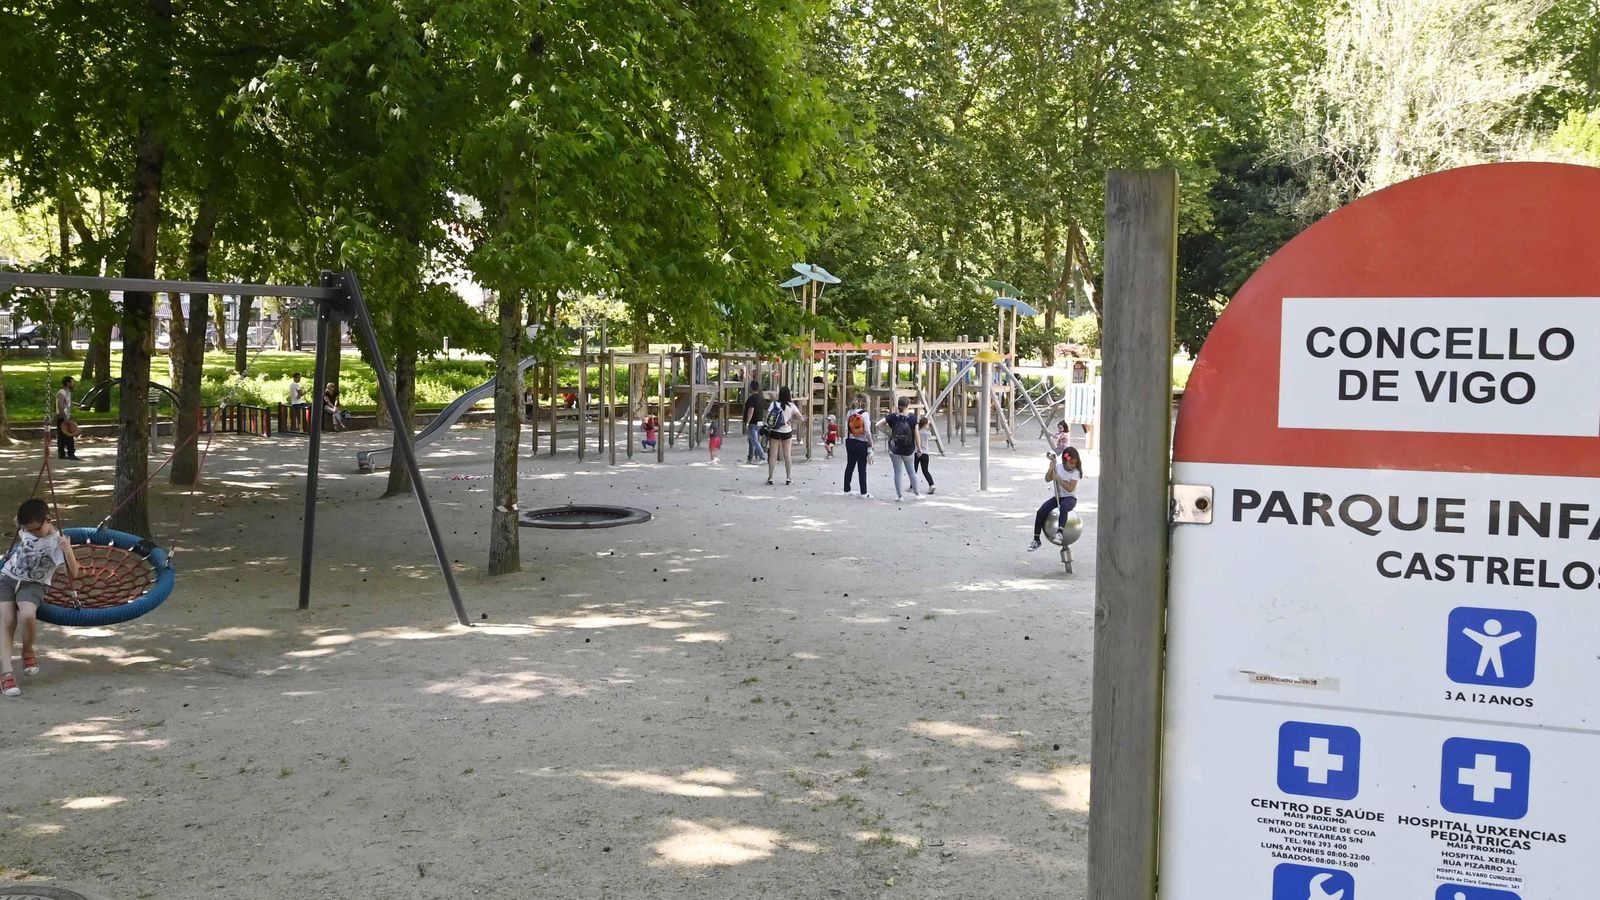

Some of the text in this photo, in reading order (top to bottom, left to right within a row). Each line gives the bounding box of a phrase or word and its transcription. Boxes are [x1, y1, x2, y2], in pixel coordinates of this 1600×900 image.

[1306, 326, 1575, 362] CONCELLO
[1338, 369, 1537, 405] DE VIGO
[1232, 488, 1466, 537] PARQUE
[1376, 551, 1600, 590] CASTRELO
[1445, 690, 1534, 708] 3 A 12 ANOS
[1250, 798, 1385, 822] CENTRO DE SAÚDE
[1257, 817, 1376, 837] CENTRO DE SAÚDE DE COIA
[1268, 826, 1363, 844] RÚA PONTEAREAS S/N
[1397, 815, 1567, 844] HOSPITAL URXENCIAS
[1430, 829, 1532, 851] PEDIÁTRICAS
[1260, 842, 1284, 850] LUNS
[1292, 846, 1325, 856] VENRES
[1327, 850, 1370, 861] 08:00-22:00
[1271, 850, 1359, 868] SÁBADOS: 08:00-15:00
[1441, 850, 1518, 866] HOSPITAL XERAL
[1436, 867, 1523, 883] HOSPITAL ALVARO CUNQUEIRO
[1442, 858, 1516, 874] RÚA PIZARRO 22
